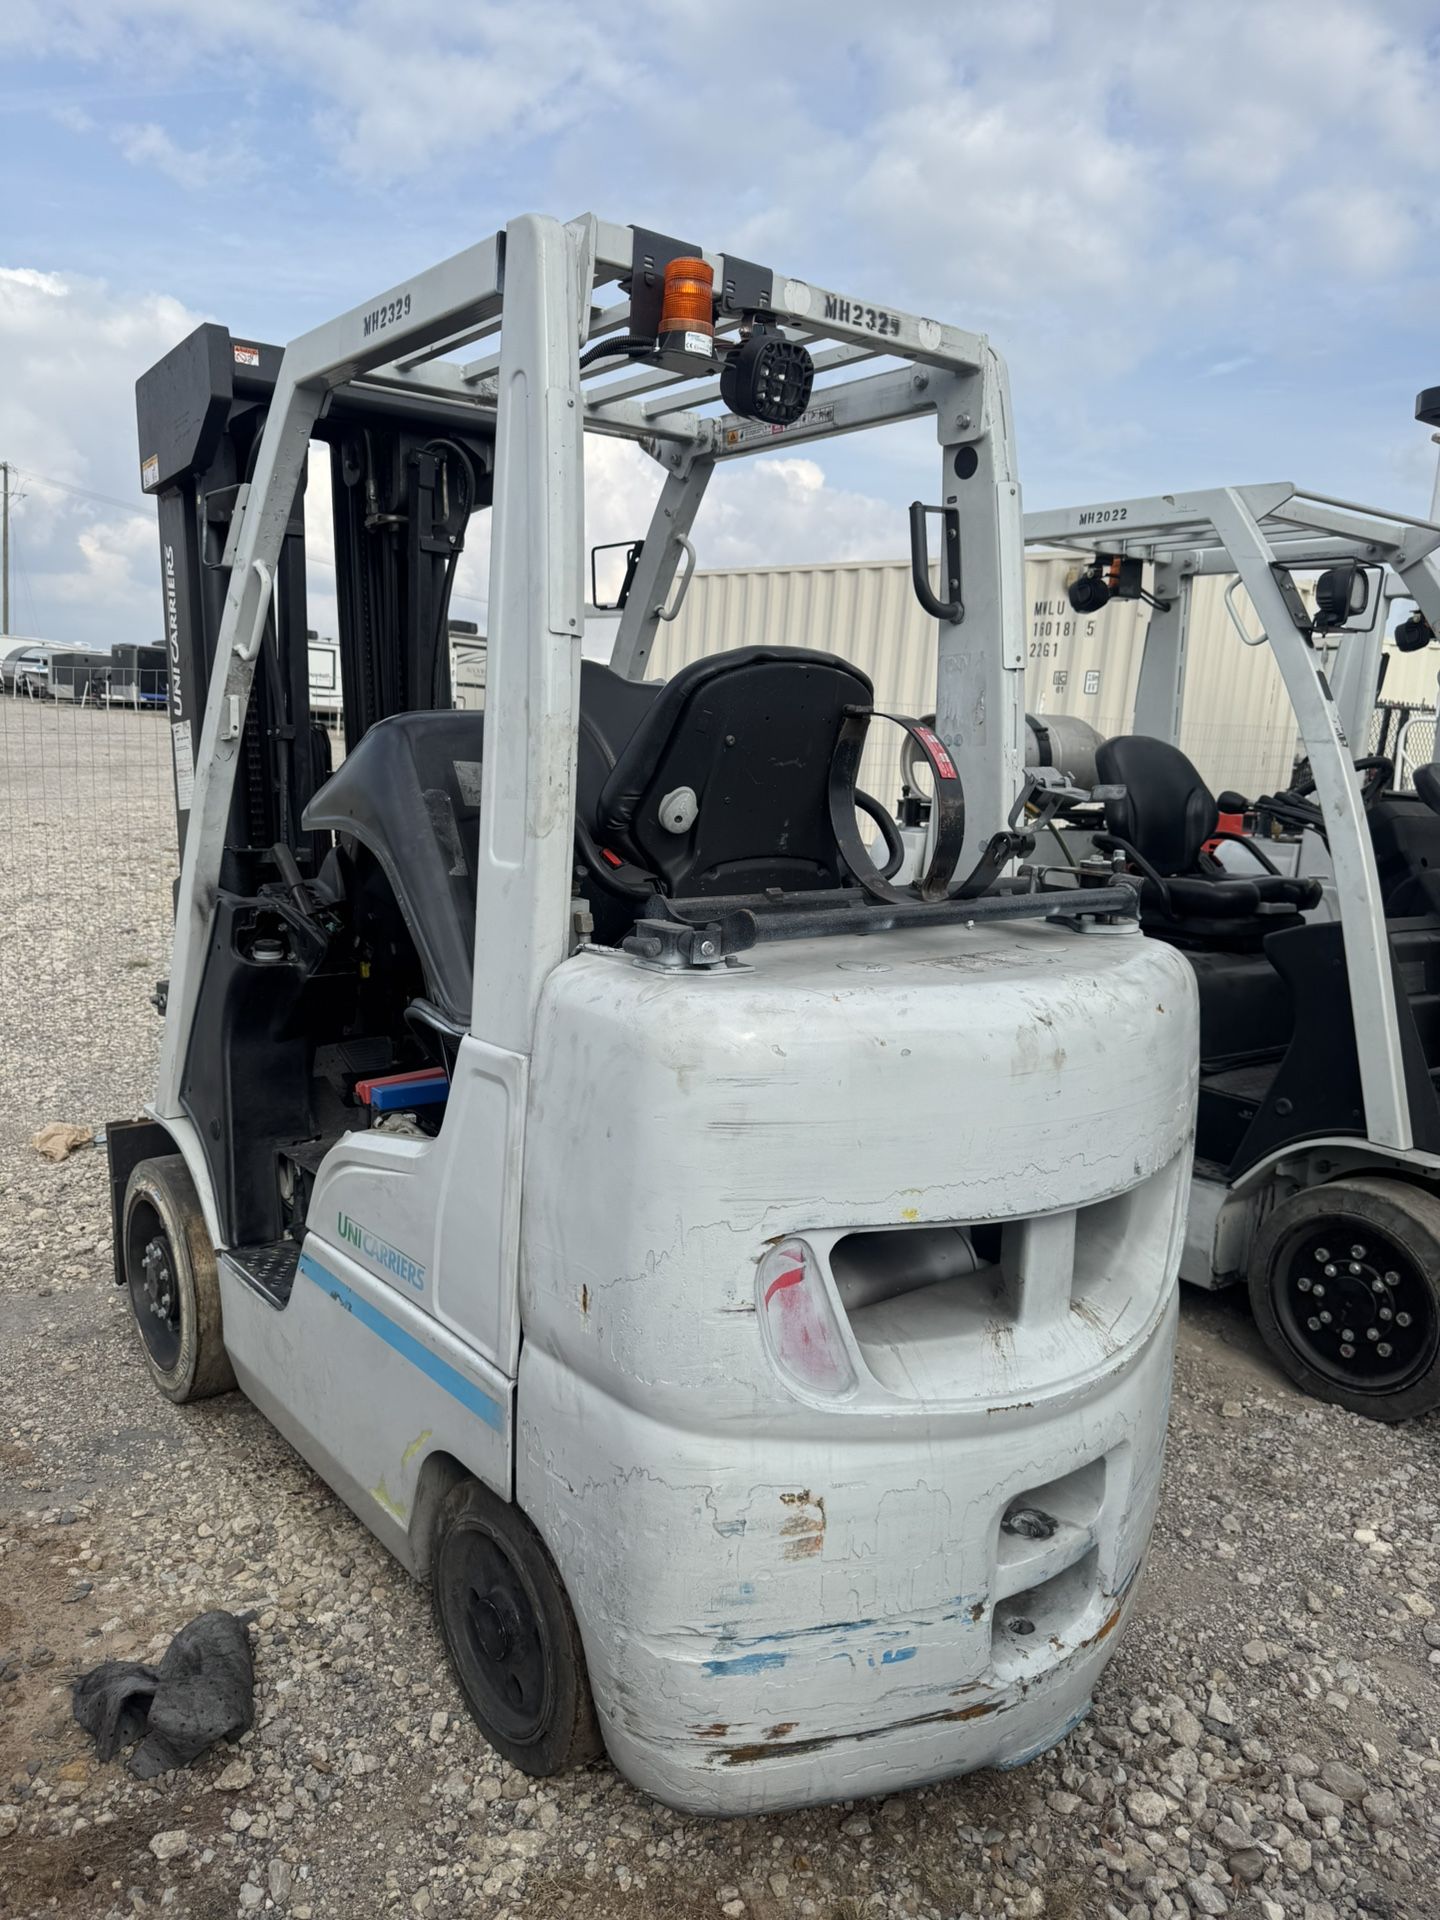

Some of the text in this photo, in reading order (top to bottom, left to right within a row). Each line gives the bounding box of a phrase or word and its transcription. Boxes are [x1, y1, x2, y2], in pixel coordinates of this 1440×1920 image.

[363, 294, 411, 337] MH2329
[1079, 508, 1128, 526] MH2022
[1086, 620, 1096, 636] 5
[1029, 642, 1058, 658] 22G1
[337, 1211, 425, 1291] UNICARRIERS
